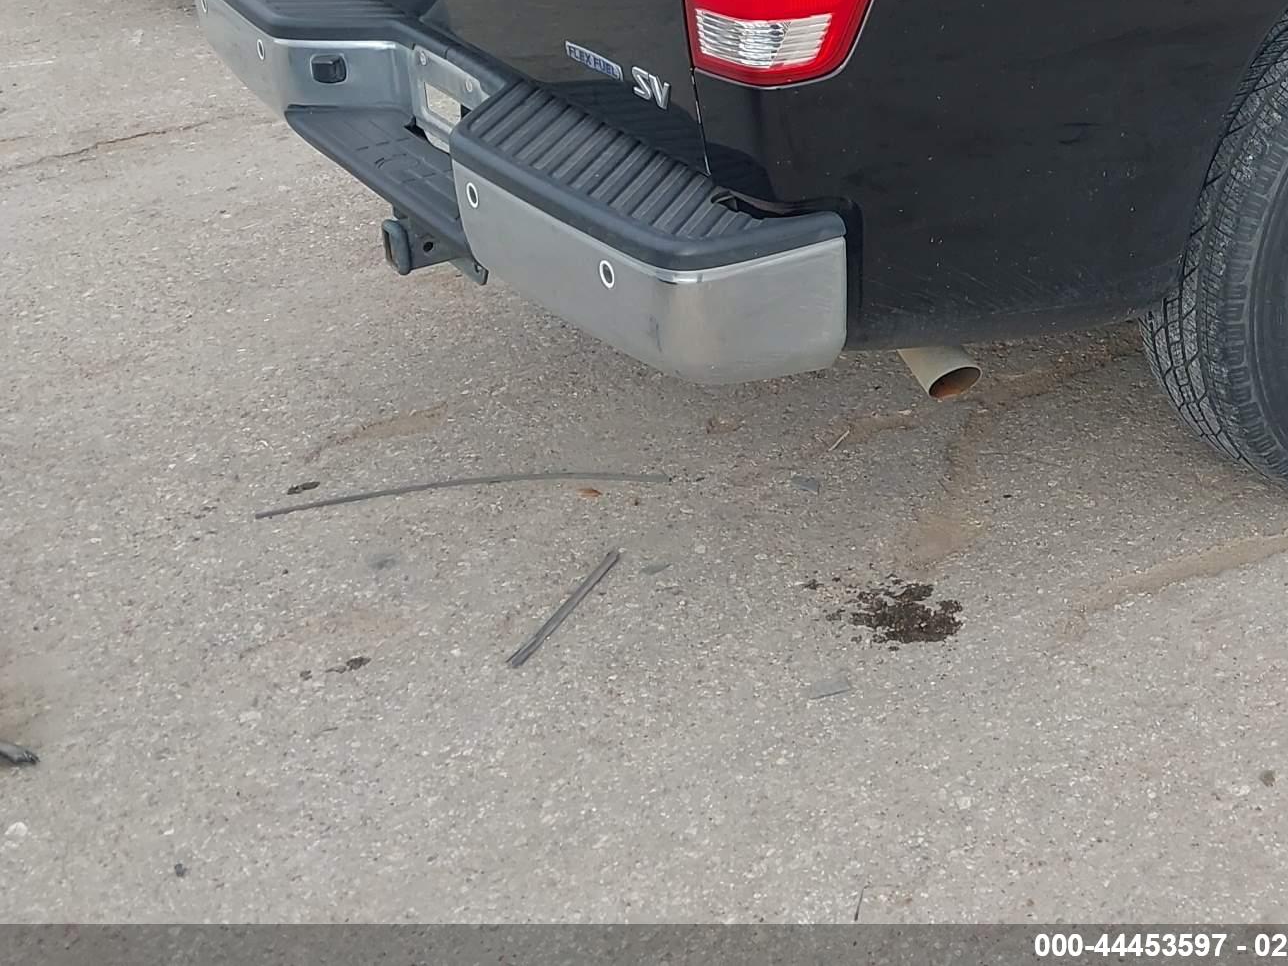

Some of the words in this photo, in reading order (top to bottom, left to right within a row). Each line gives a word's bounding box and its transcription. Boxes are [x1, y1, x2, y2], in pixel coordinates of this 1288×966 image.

[567, 45, 592, 68] FLEX
[593, 56, 618, 78] FUEL
[632, 66, 670, 110] SV
